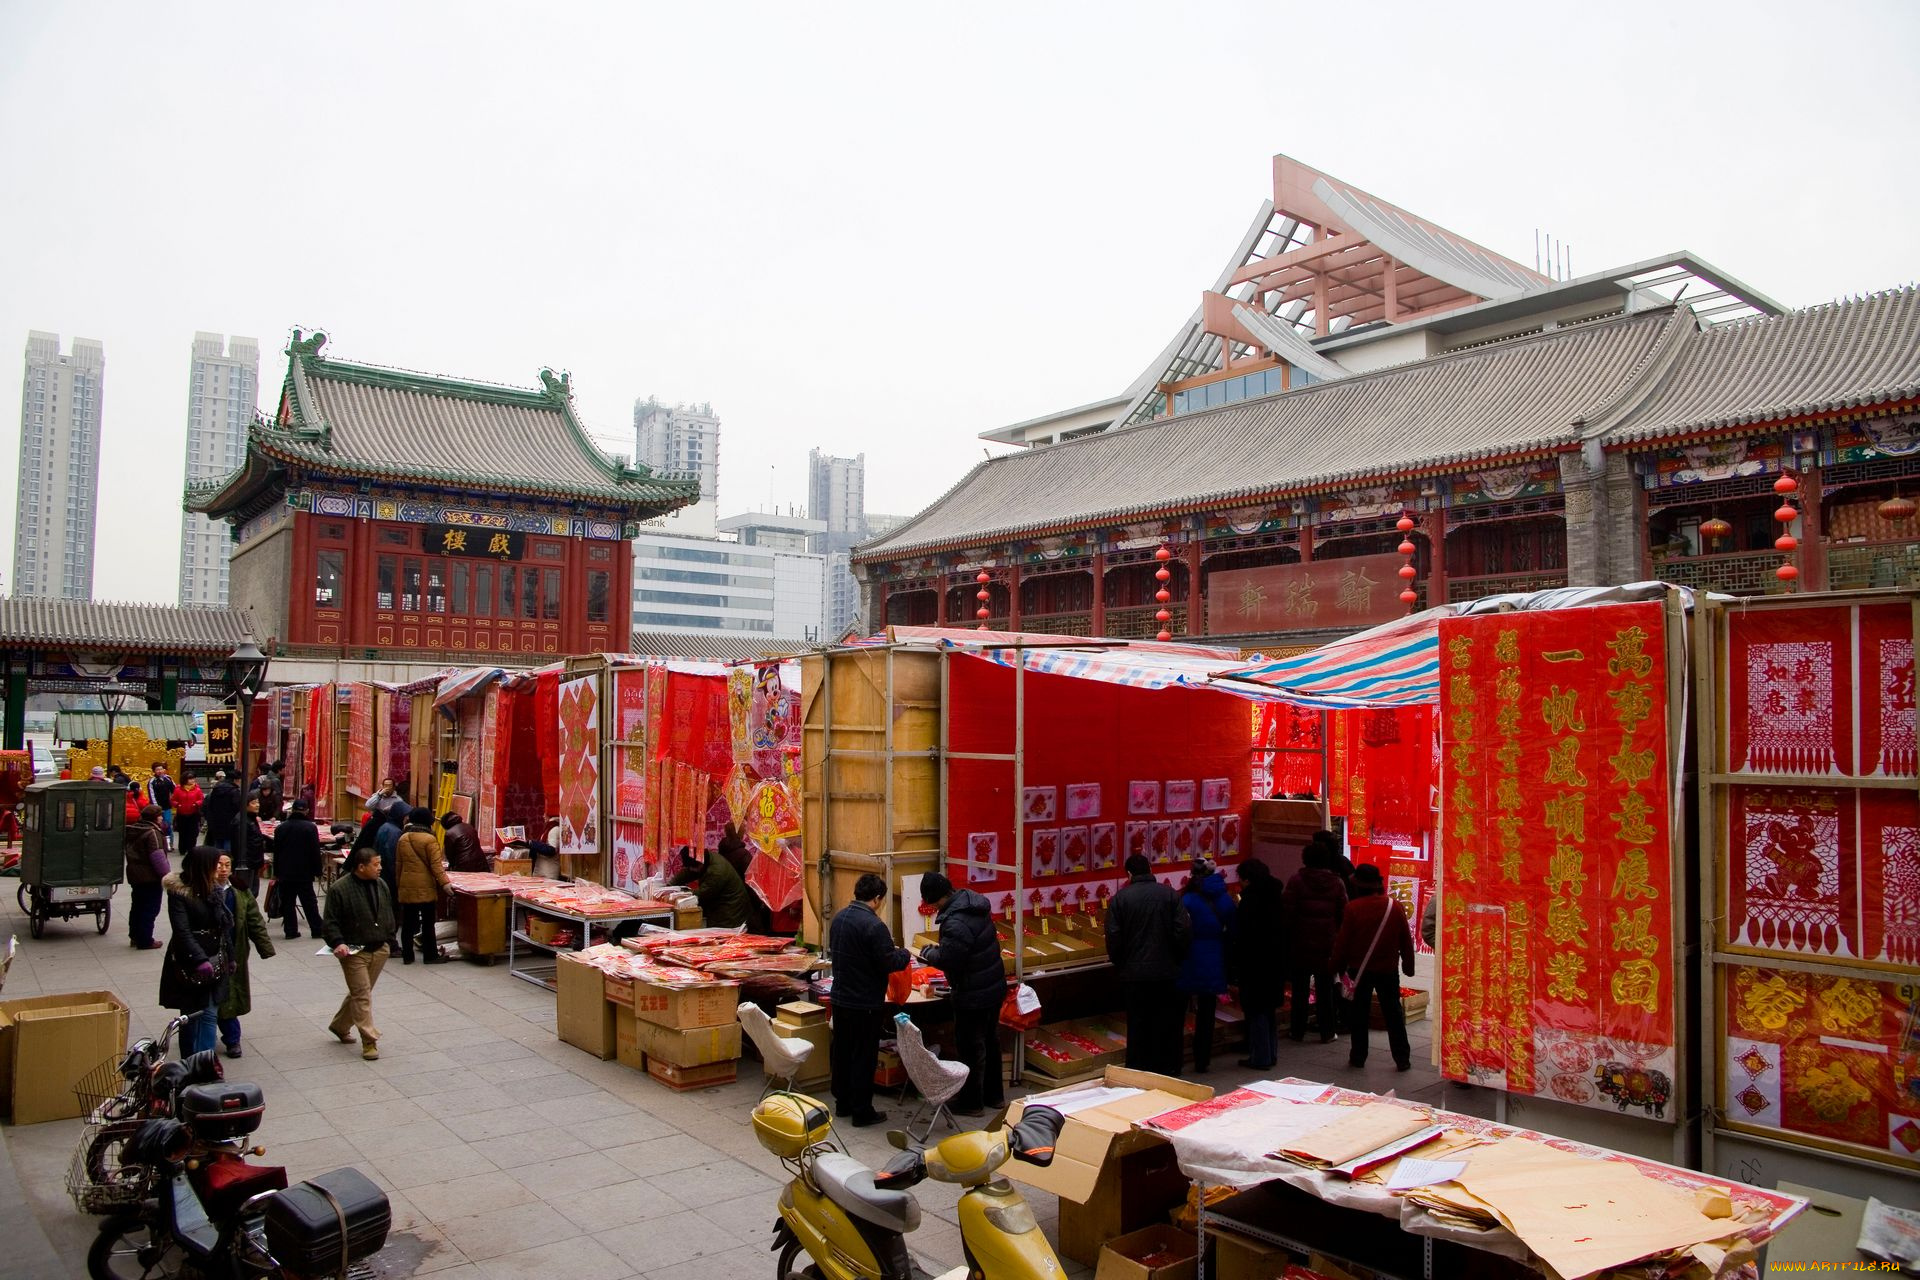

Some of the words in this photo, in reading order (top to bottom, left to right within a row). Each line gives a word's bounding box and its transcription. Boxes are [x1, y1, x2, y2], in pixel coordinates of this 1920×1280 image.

[1541, 649, 1588, 1001] 一帆風順興駿業
[1606, 626, 1660, 1013] 萬事如意展鴻圖
